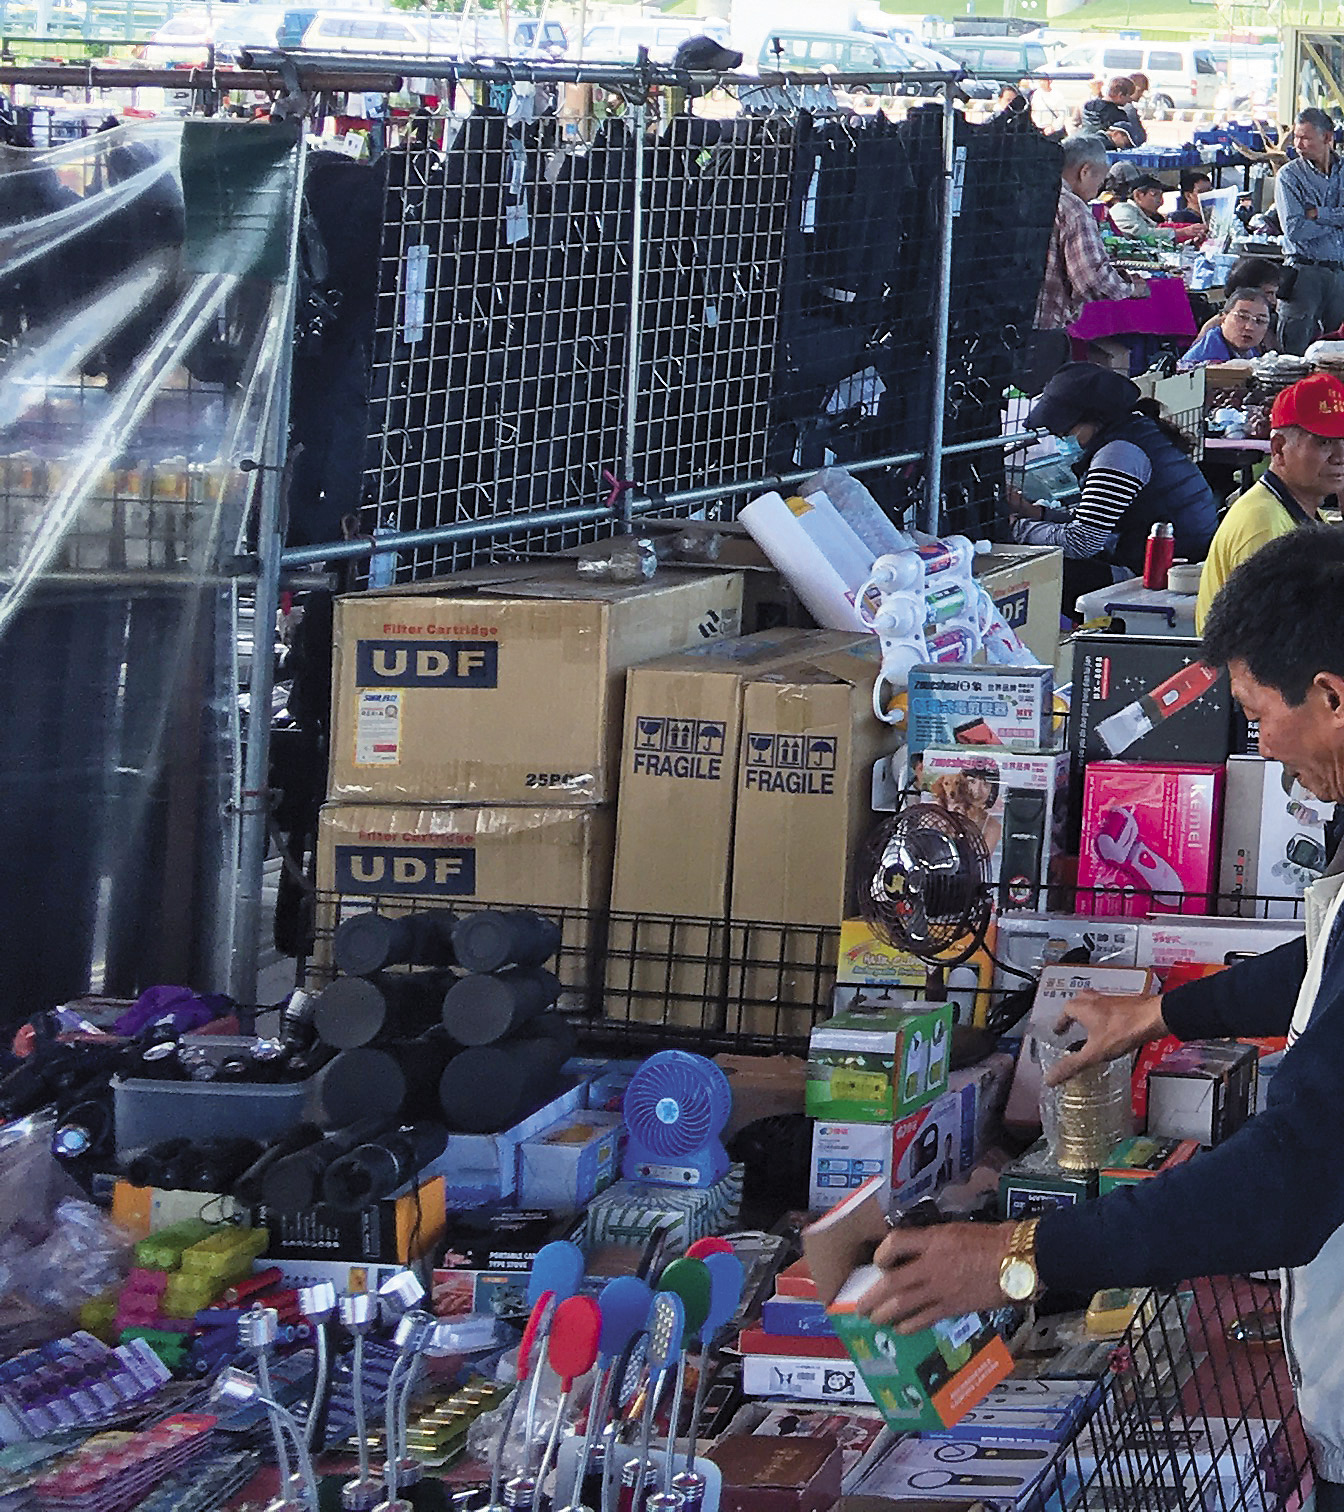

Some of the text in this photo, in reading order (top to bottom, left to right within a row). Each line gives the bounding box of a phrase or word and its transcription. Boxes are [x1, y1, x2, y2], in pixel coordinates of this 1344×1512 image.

[999, 597, 1026, 624] DF
[383, 623, 498, 637] Filter Cartridge
[372, 650, 485, 677] UDF
[633, 753, 722, 780] FRAGILE
[745, 769, 834, 795] FRAGILE
[350, 855, 463, 884] UDF
[489, 1251, 523, 1260] PORTABLE
[507, 1261, 528, 1269] STOVE
